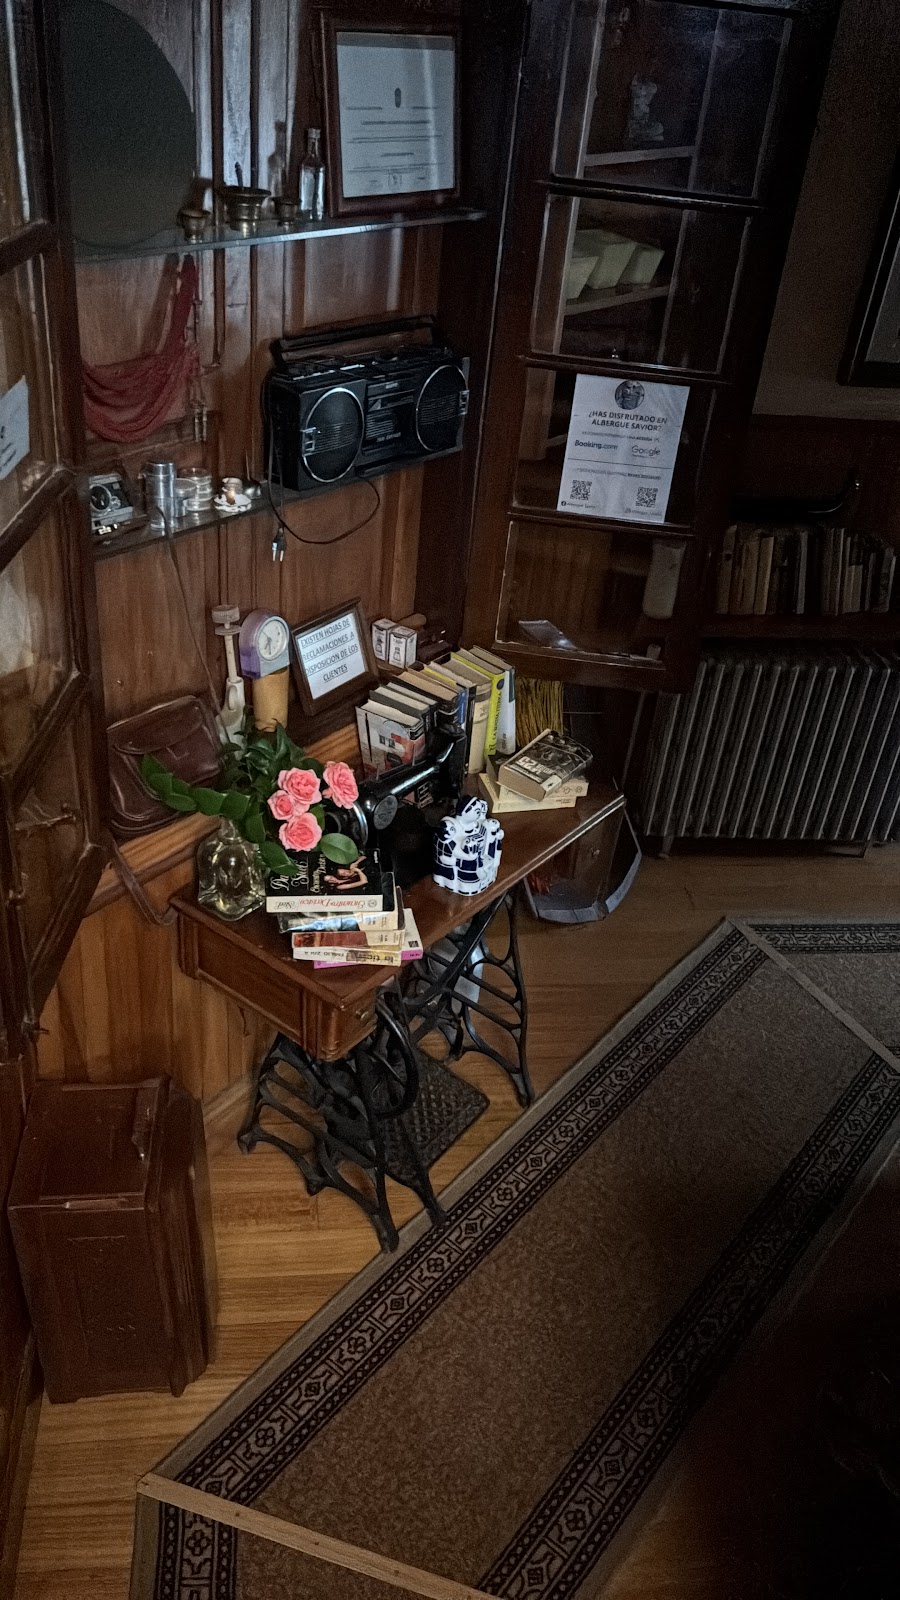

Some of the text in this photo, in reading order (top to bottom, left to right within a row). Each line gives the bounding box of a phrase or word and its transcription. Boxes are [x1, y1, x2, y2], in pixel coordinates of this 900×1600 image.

[592, 419, 629, 428] ALBERGUE
[608, 412, 655, 422] DISFRUTADO
[574, 440, 660, 456] Booking.com Google
[301, 619, 350, 648] EXISTEN HOJAS DE
[303, 635, 348, 660] RECLAMACIONES
[340, 649, 347, 658] DE
[348, 644, 358, 654] LOS
[323, 664, 348, 682] CLIENTES
